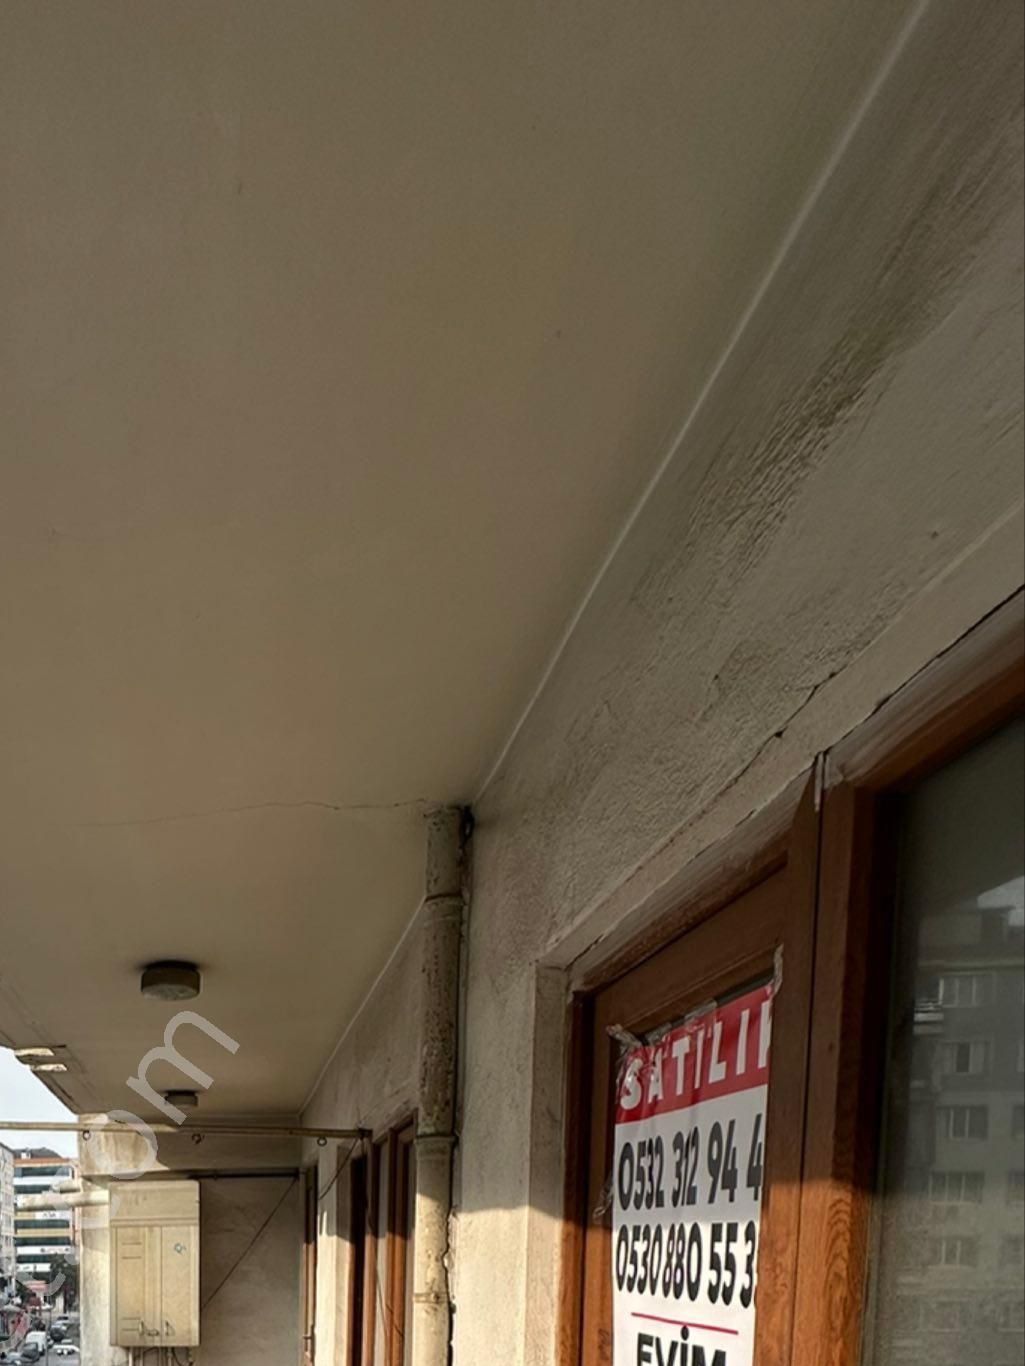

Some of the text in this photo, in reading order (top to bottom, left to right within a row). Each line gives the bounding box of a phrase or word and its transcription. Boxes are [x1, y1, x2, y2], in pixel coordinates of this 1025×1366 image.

[618, 1135, 665, 1211] 0532
[672, 1126, 700, 1208] 312
[707, 1119, 738, 1204] 94
[707, 1221, 739, 1307] 55
[739, 1220, 756, 1309] 3
